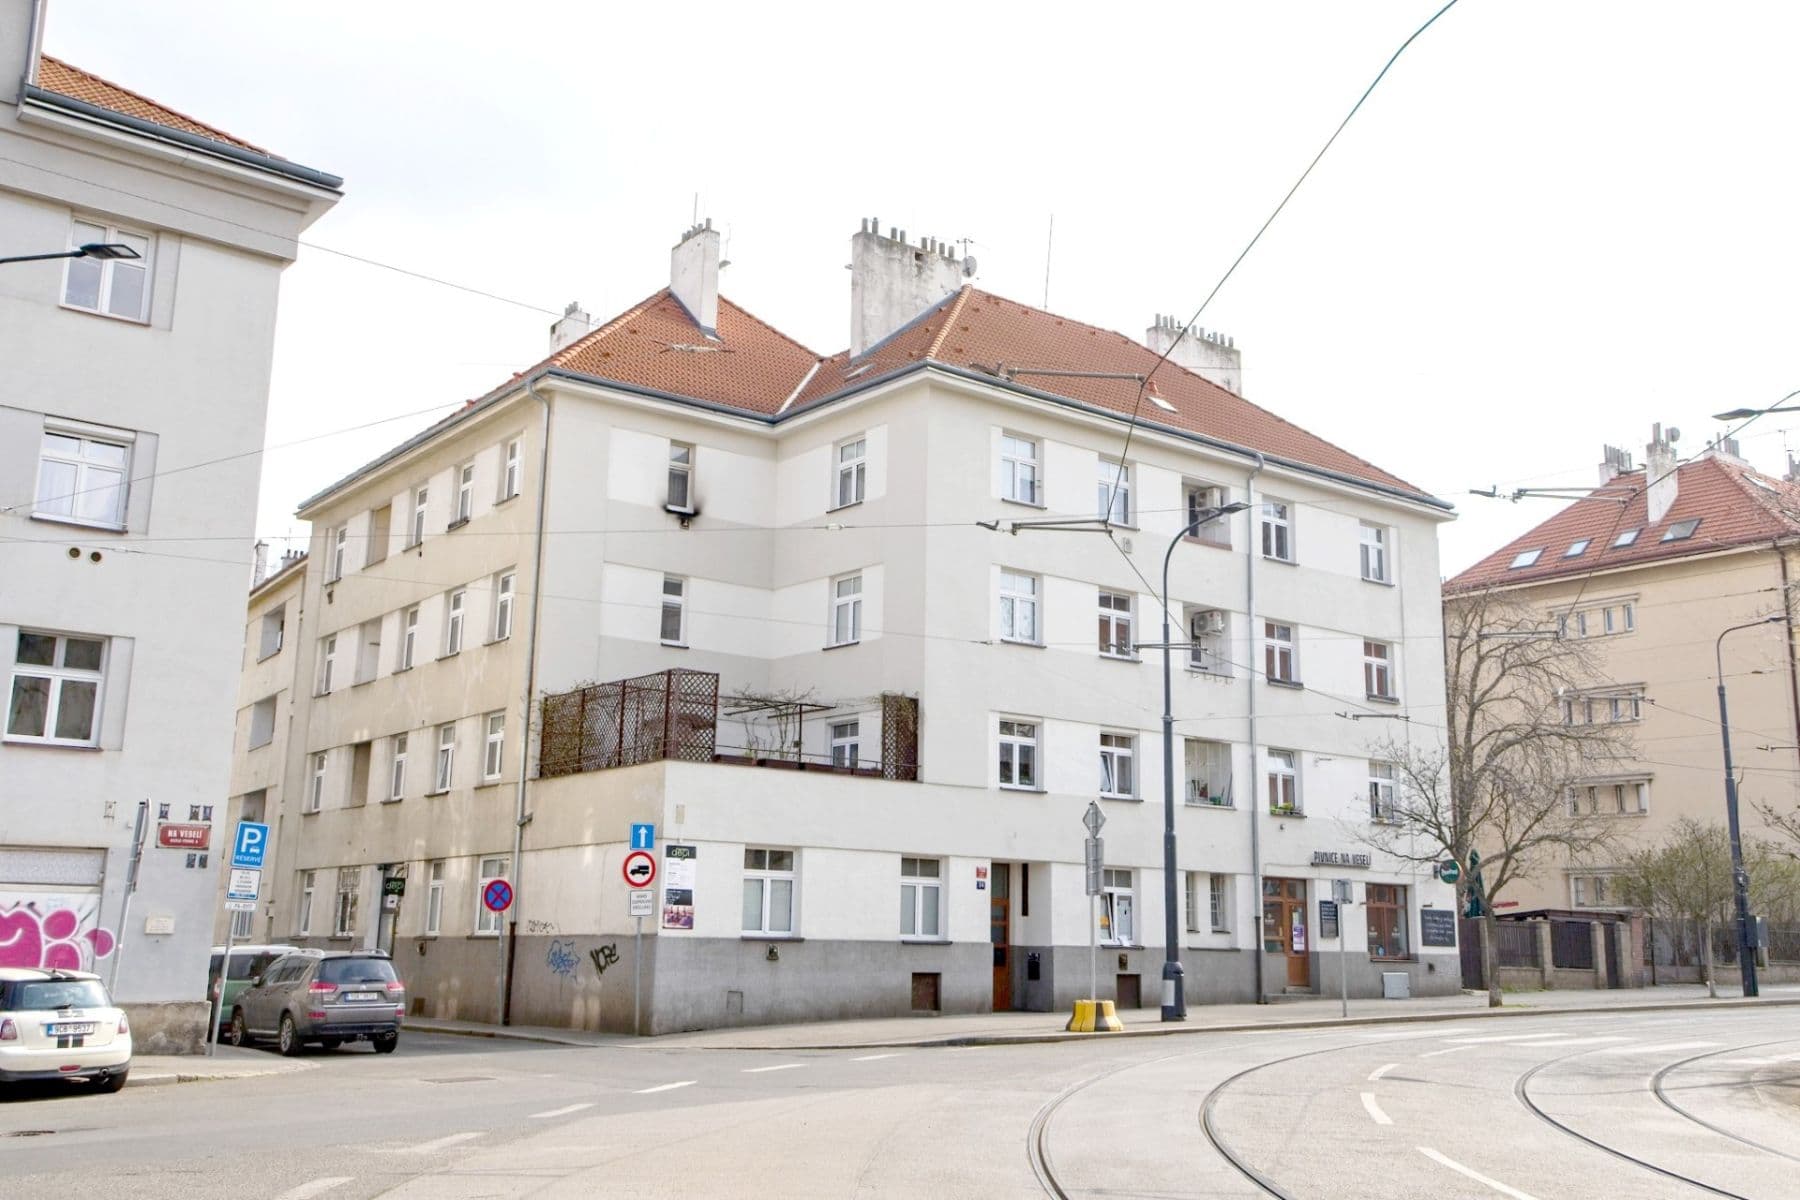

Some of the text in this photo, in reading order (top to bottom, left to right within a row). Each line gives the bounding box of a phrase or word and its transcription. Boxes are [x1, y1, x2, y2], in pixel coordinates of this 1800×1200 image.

[167, 829, 203, 839] NA VESELÍ
[241, 827, 262, 853] P
[1313, 851, 1338, 864] PIVNICE
[1340, 852, 1350, 864] NA
